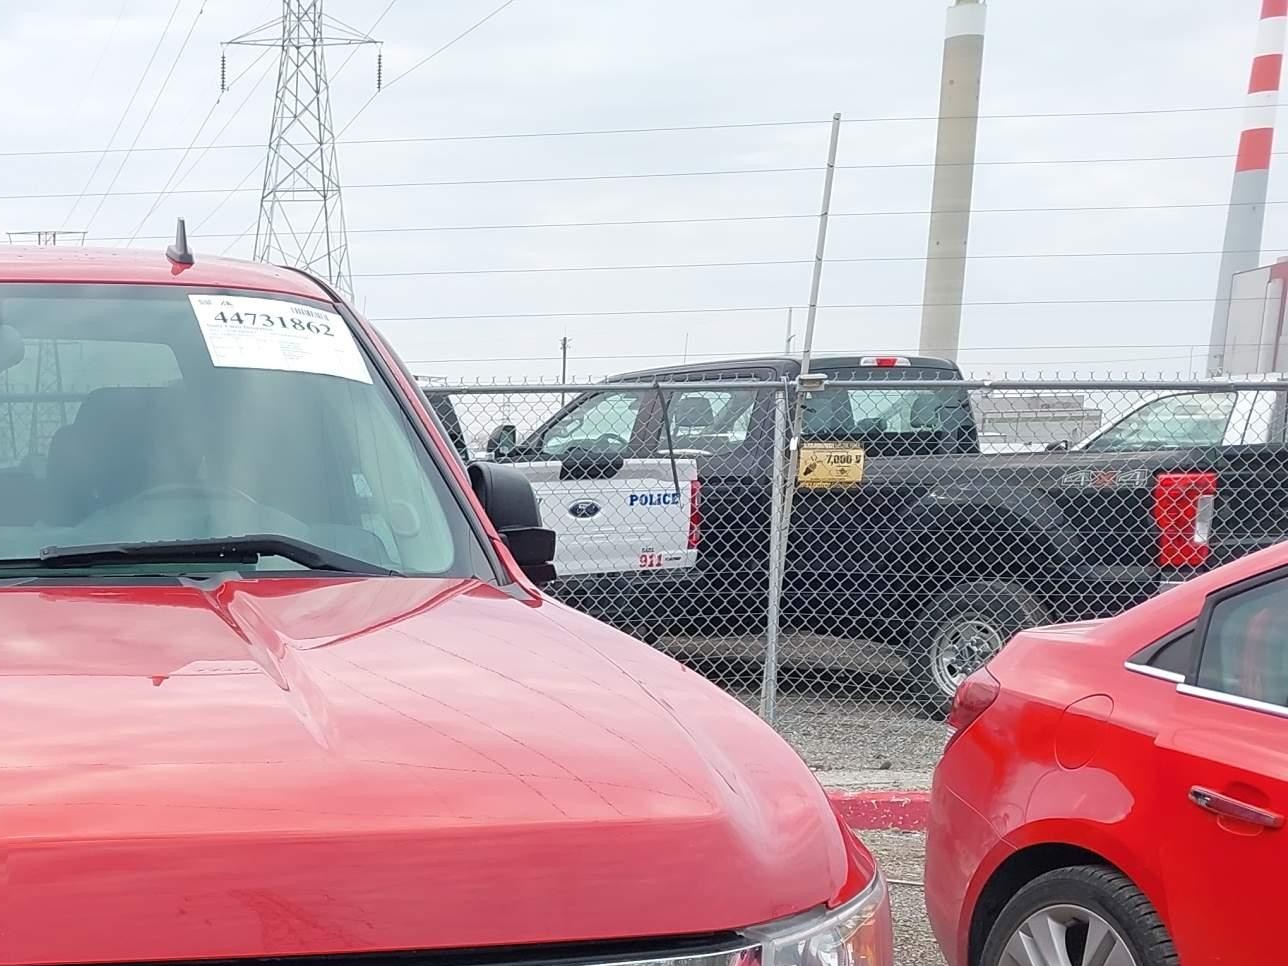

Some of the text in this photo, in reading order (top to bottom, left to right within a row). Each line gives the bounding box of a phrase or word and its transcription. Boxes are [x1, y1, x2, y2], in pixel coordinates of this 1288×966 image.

[214, 311, 334, 337] 44731862
[629, 493, 680, 506] POLICE
[639, 554, 663, 568] 911
